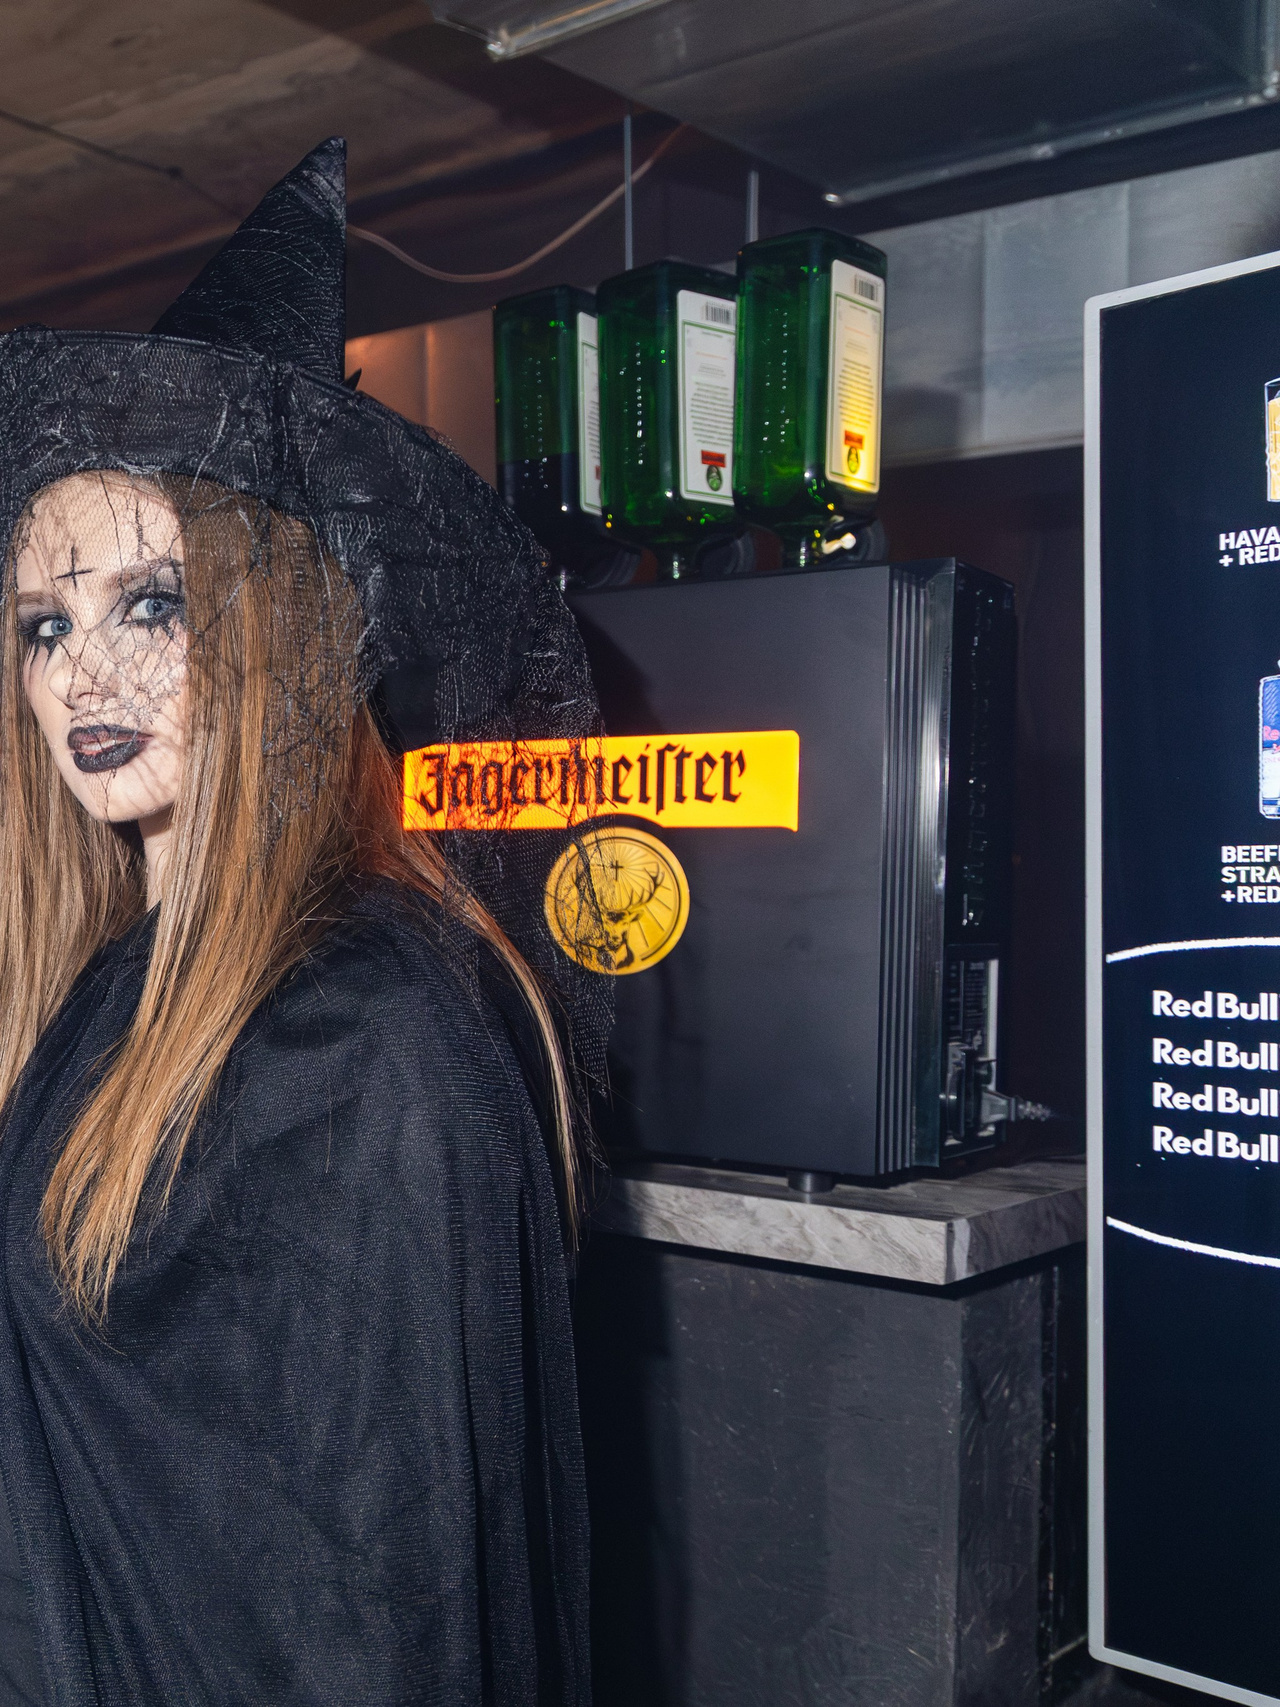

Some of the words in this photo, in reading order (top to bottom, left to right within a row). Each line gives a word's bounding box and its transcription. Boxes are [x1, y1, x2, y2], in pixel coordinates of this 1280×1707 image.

[1239, 543, 1280, 566] RED
[1221, 865, 1280, 884] STRA
[1152, 989, 1213, 1018] Red
[1217, 992, 1279, 1021] Bull
[1152, 1037, 1213, 1067] Red
[1217, 1041, 1279, 1071] Bull
[1152, 1081, 1214, 1112] Red
[1217, 1086, 1279, 1118] Bull
[1152, 1125, 1214, 1157] Red
[1217, 1131, 1279, 1163] Bull
